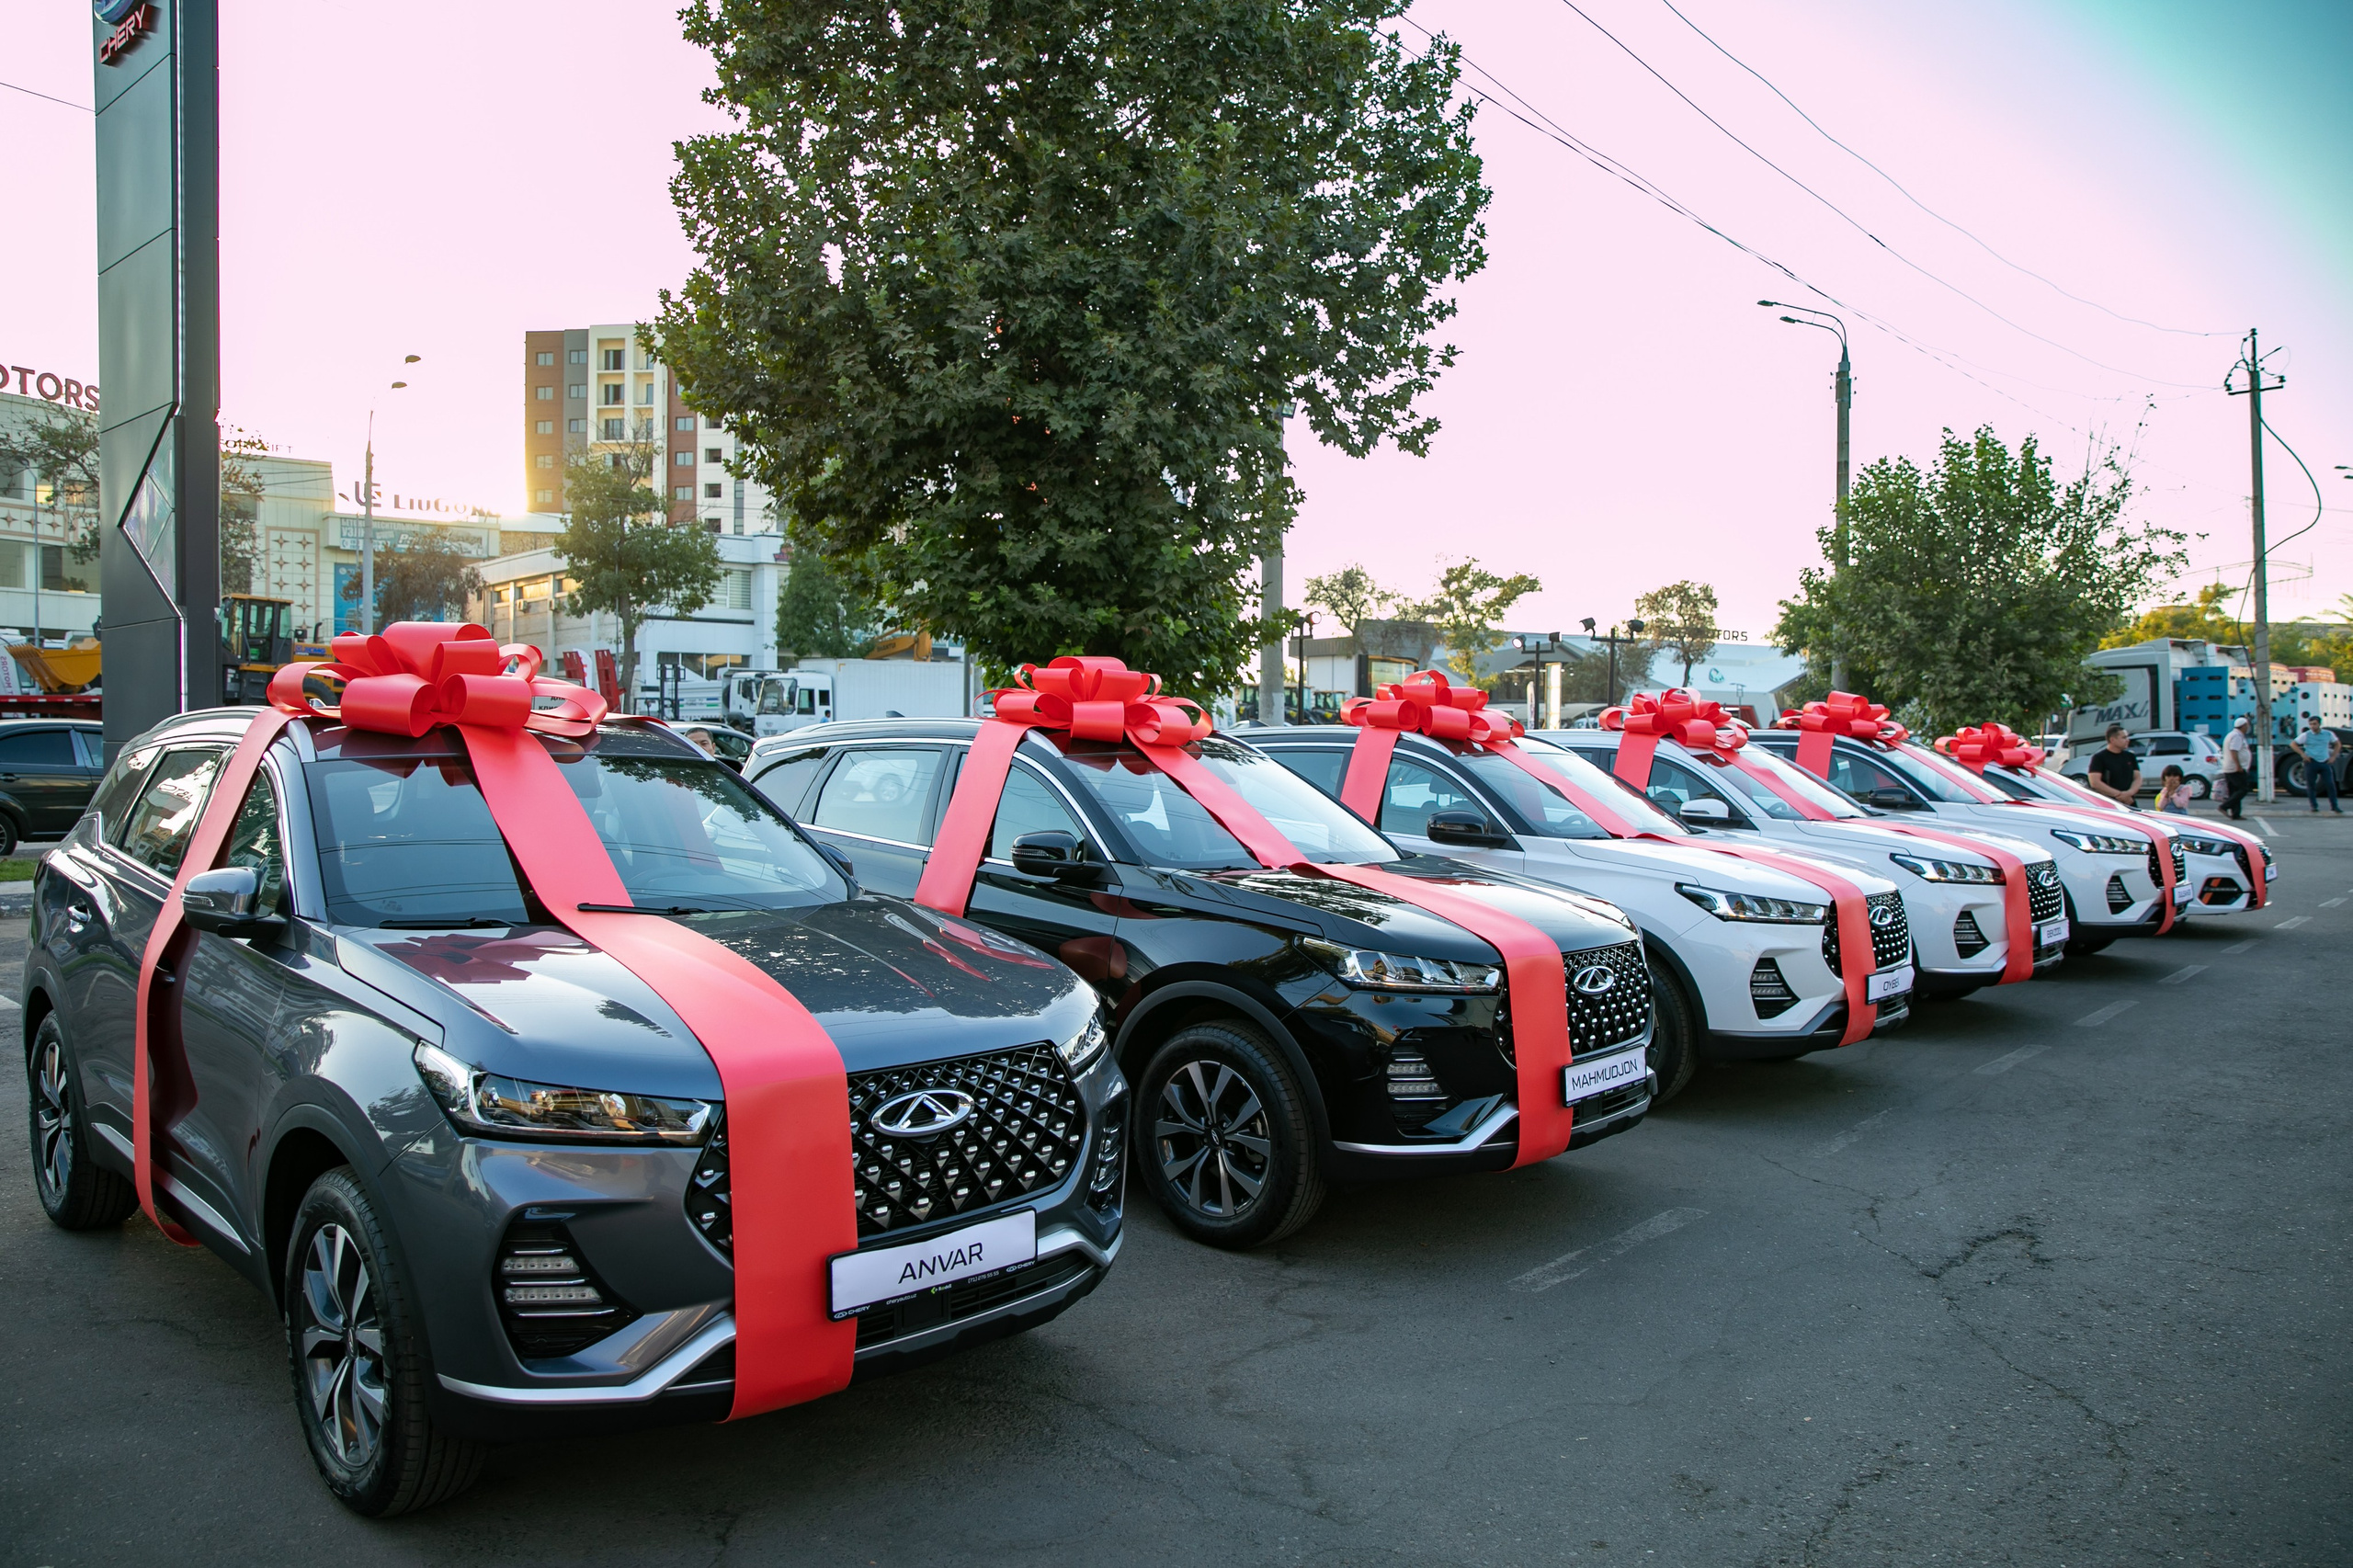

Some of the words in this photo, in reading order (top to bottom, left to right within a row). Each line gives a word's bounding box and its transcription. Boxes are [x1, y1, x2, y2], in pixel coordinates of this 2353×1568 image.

[98, 3, 145, 63] CHERY
[1571, 1058, 1638, 1090] MAHMUDJON
[897, 1242, 983, 1284] ANVAR
[847, 1305, 870, 1315] CHERY
[886, 1293, 917, 1305] cheryauto.uz
